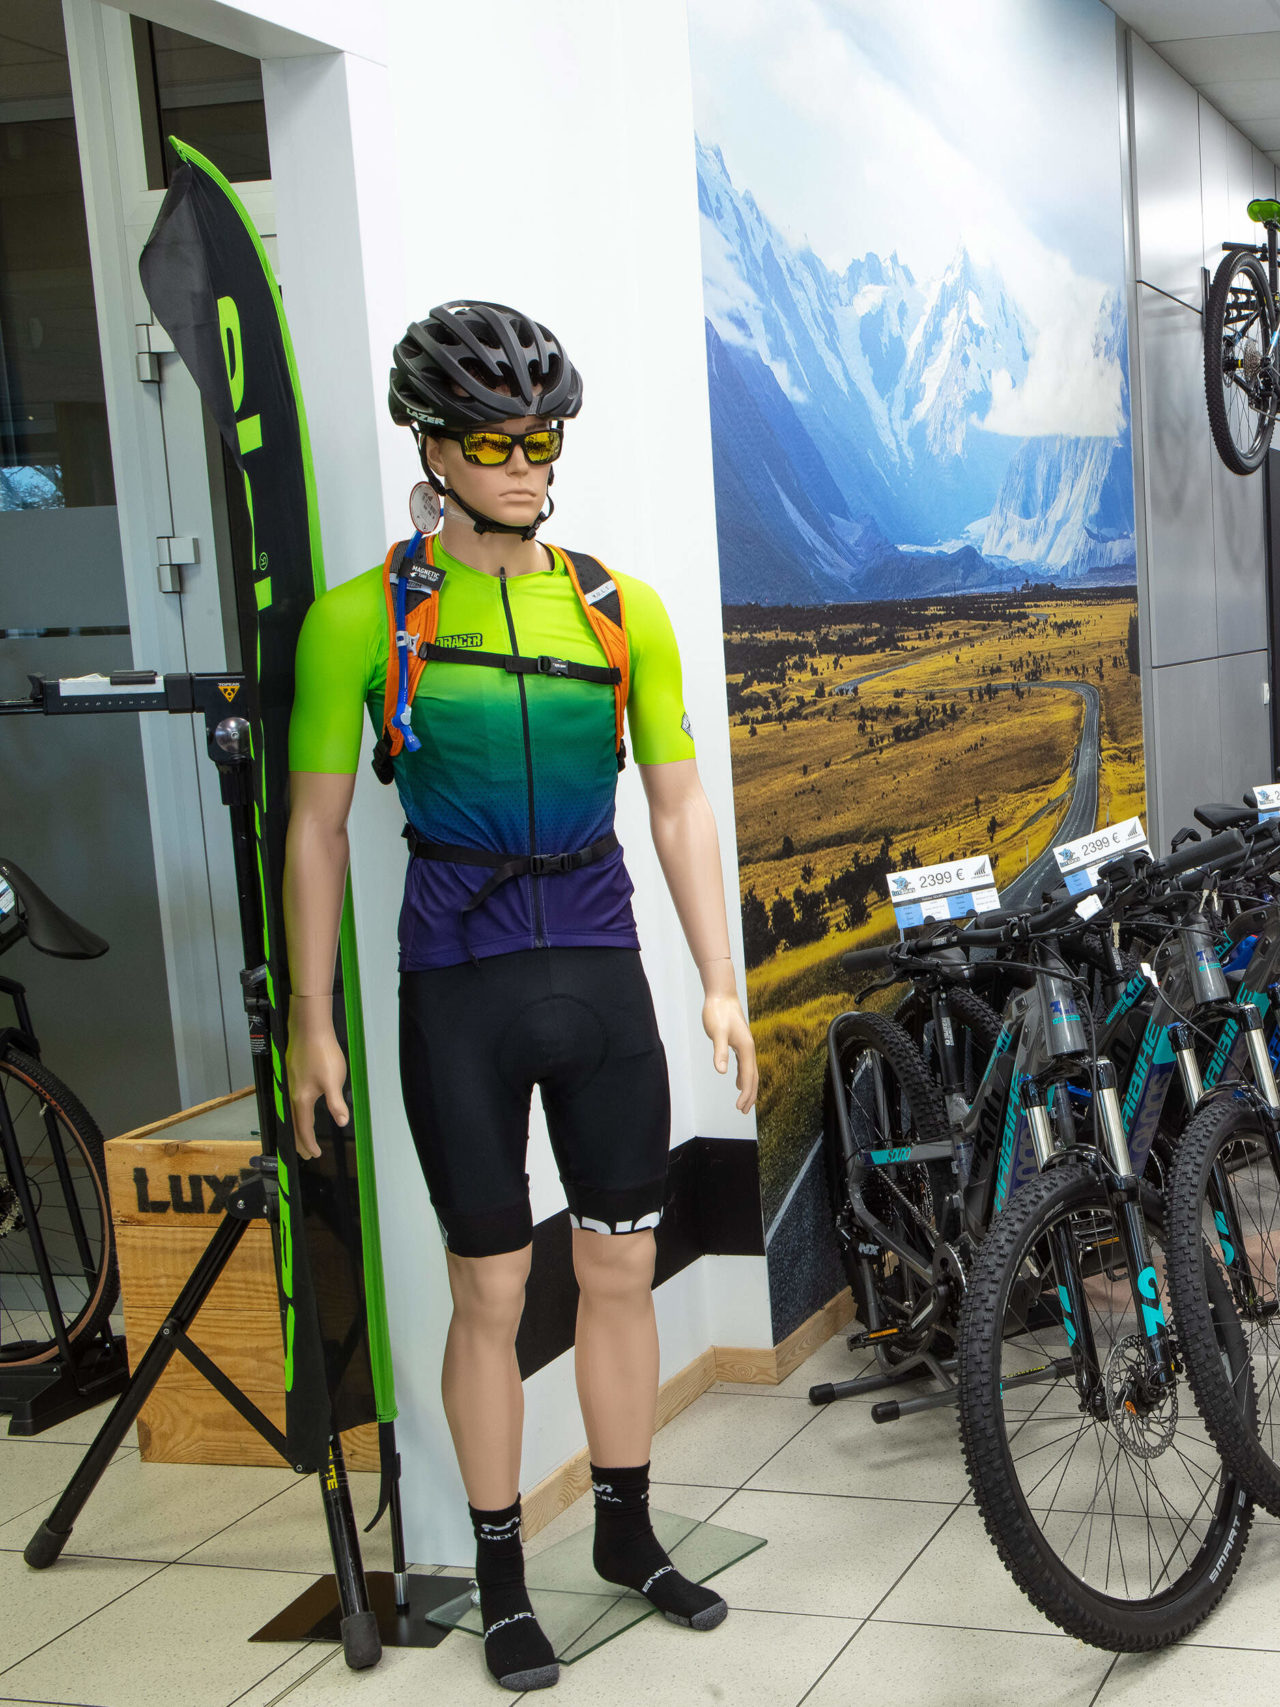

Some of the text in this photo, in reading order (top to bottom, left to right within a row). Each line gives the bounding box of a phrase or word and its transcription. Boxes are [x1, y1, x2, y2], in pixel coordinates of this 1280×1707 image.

[406, 408, 445, 426] LAZER
[411, 564, 440, 579] MAGNETIC
[1081, 832, 1121, 856] 2399 €
[918, 868, 965, 889] 2399 €
[1121, 1015, 1161, 1138] AIBIKE
[133, 1167, 257, 1215] Lux
[858, 1242, 880, 1256] NX
[1208, 1514, 1240, 1584] SMART
